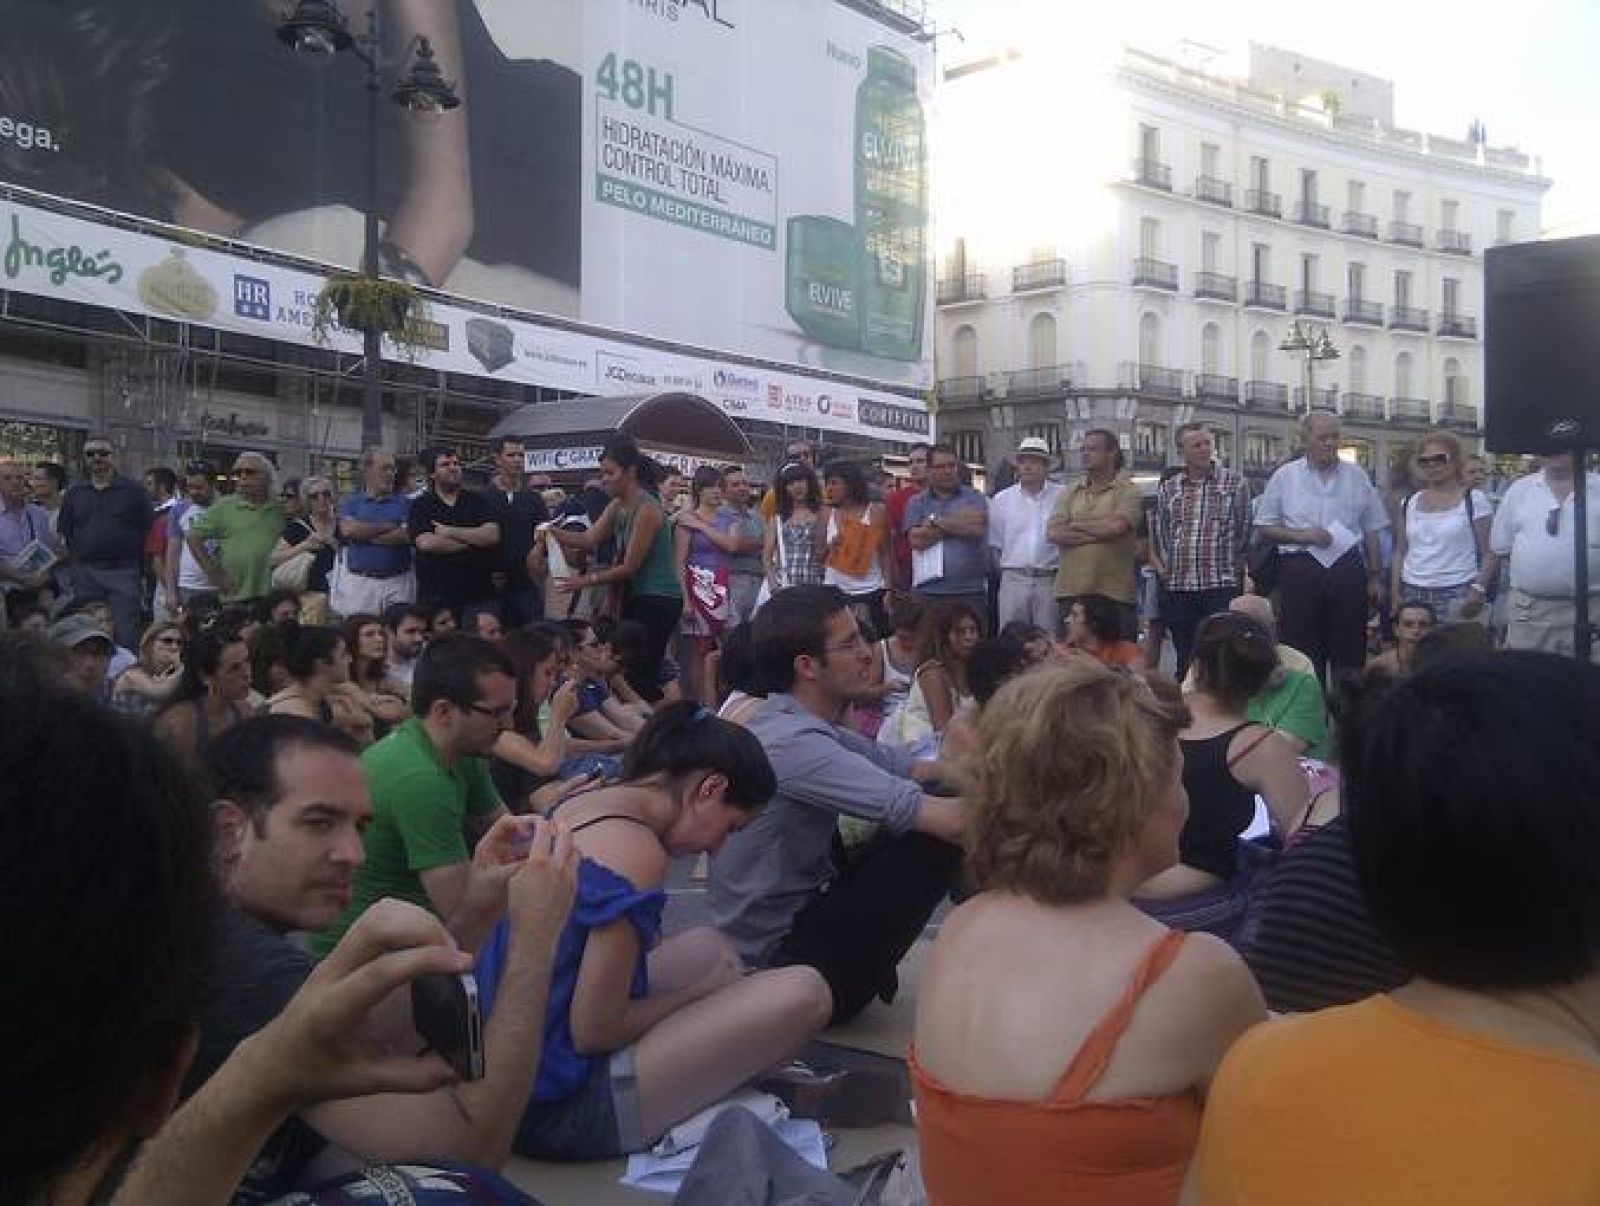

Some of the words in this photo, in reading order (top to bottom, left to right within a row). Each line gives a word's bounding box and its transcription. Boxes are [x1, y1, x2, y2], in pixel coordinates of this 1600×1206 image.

[596, 52, 673, 120] 48H
[602, 143, 676, 188] CONTROL
[680, 169, 729, 204] TOTAL
[603, 181, 647, 208] PELO
[236, 279, 268, 305] HR
